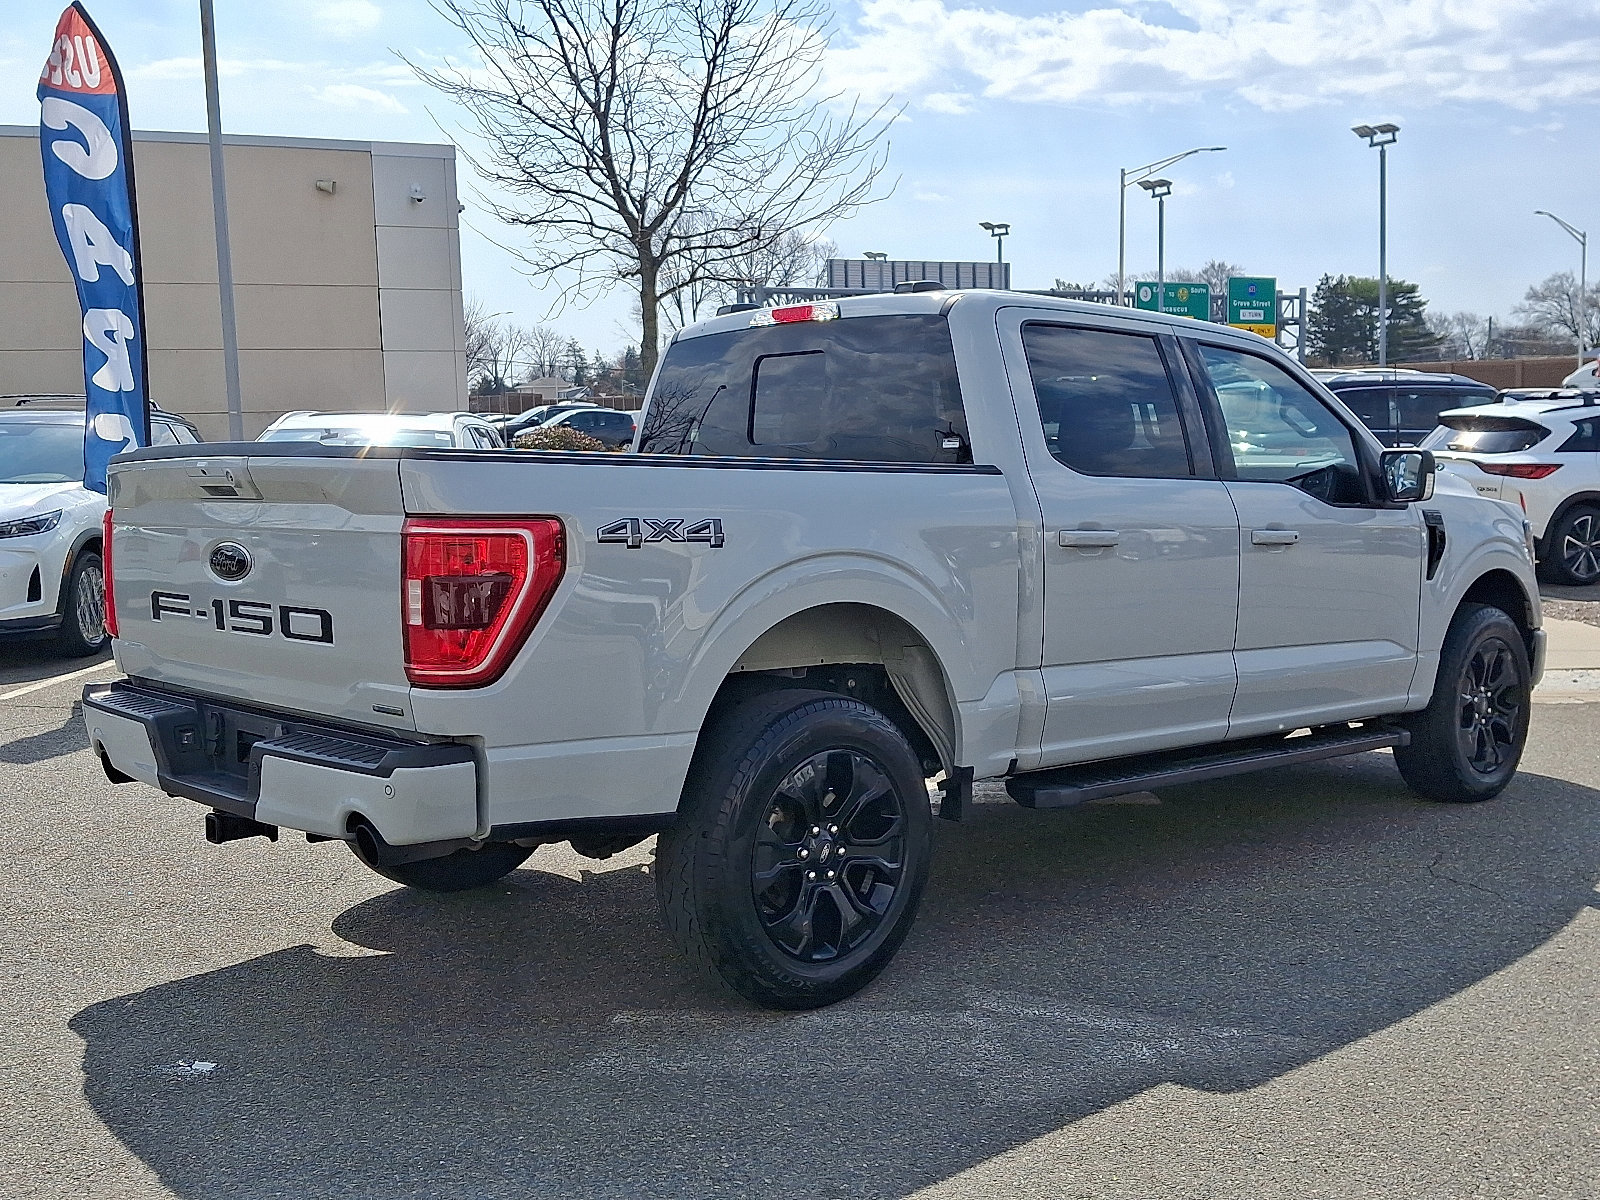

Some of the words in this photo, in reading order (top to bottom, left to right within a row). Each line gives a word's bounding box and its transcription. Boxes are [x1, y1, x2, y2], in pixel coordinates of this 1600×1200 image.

[1190, 286, 1206, 294] SOUTH
[1232, 299, 1251, 307] Grove
[1252, 299, 1271, 307] Street
[210, 548, 240, 572] Ford
[150, 590, 335, 647] F-150
